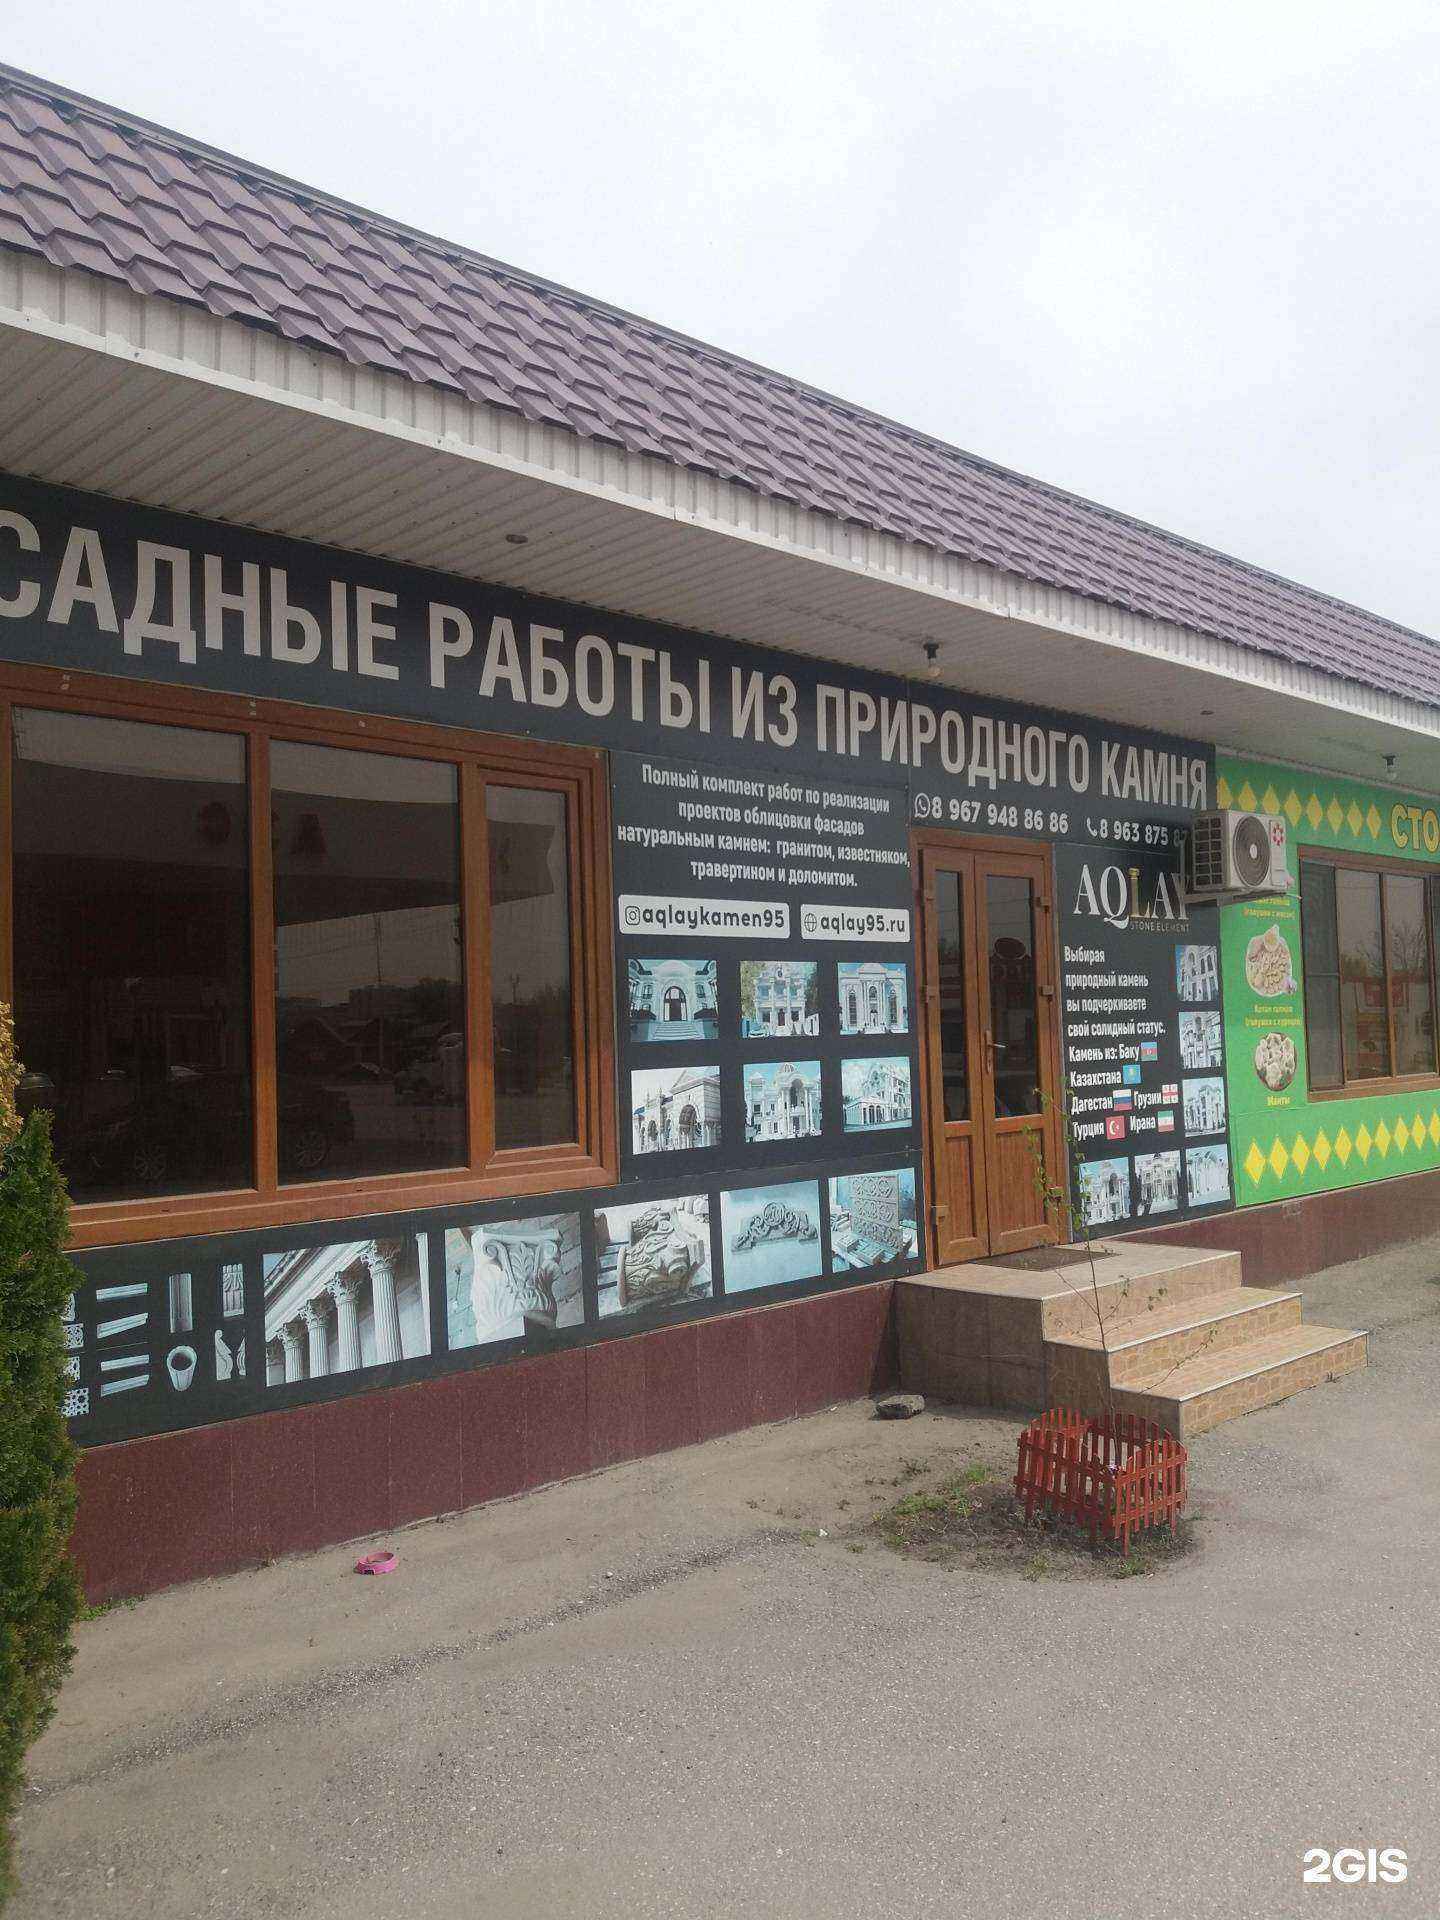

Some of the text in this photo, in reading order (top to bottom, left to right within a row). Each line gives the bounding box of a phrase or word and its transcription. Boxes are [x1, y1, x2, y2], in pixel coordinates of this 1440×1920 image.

[428, 602, 711, 734] РАБОТЫ
[731, 666, 798, 749] ИЗ
[816, 684, 1090, 794] ПРИРОДНОГО
[1101, 740, 1208, 811] КАМНЯ
[642, 763, 890, 813] Полный комплект работ по реализации
[678, 801, 865, 837] проектов облицовки фасадов
[931, 796, 1069, 834] 8 967 948 86 86
[1100, 818, 1108, 839] 8
[1113, 820, 1140, 842] 963
[1144, 824, 1169, 846] 875
[617, 825, 912, 868] натуральным камнем: гранитом, известняком,
[690, 861, 858, 887] травертином и доломитом.
[642, 904, 785, 930] aqlaykamen95
[820, 912, 906, 935] aqlay95.ru
[1064, 945, 1105, 966] Выбирая
[1066, 971, 1149, 990] природный камень
[1067, 999, 1147, 1014] вы подчеркиваете
[1068, 1018, 1166, 1037] свой солидный статус.
[1069, 1043, 1140, 1062] Камень из: Баку
[1070, 1071, 1122, 1087] Казахстана
[1071, 1090, 1162, 1115] Дагестан Грузии
[1073, 1115, 1156, 1141] Турция Ирана
